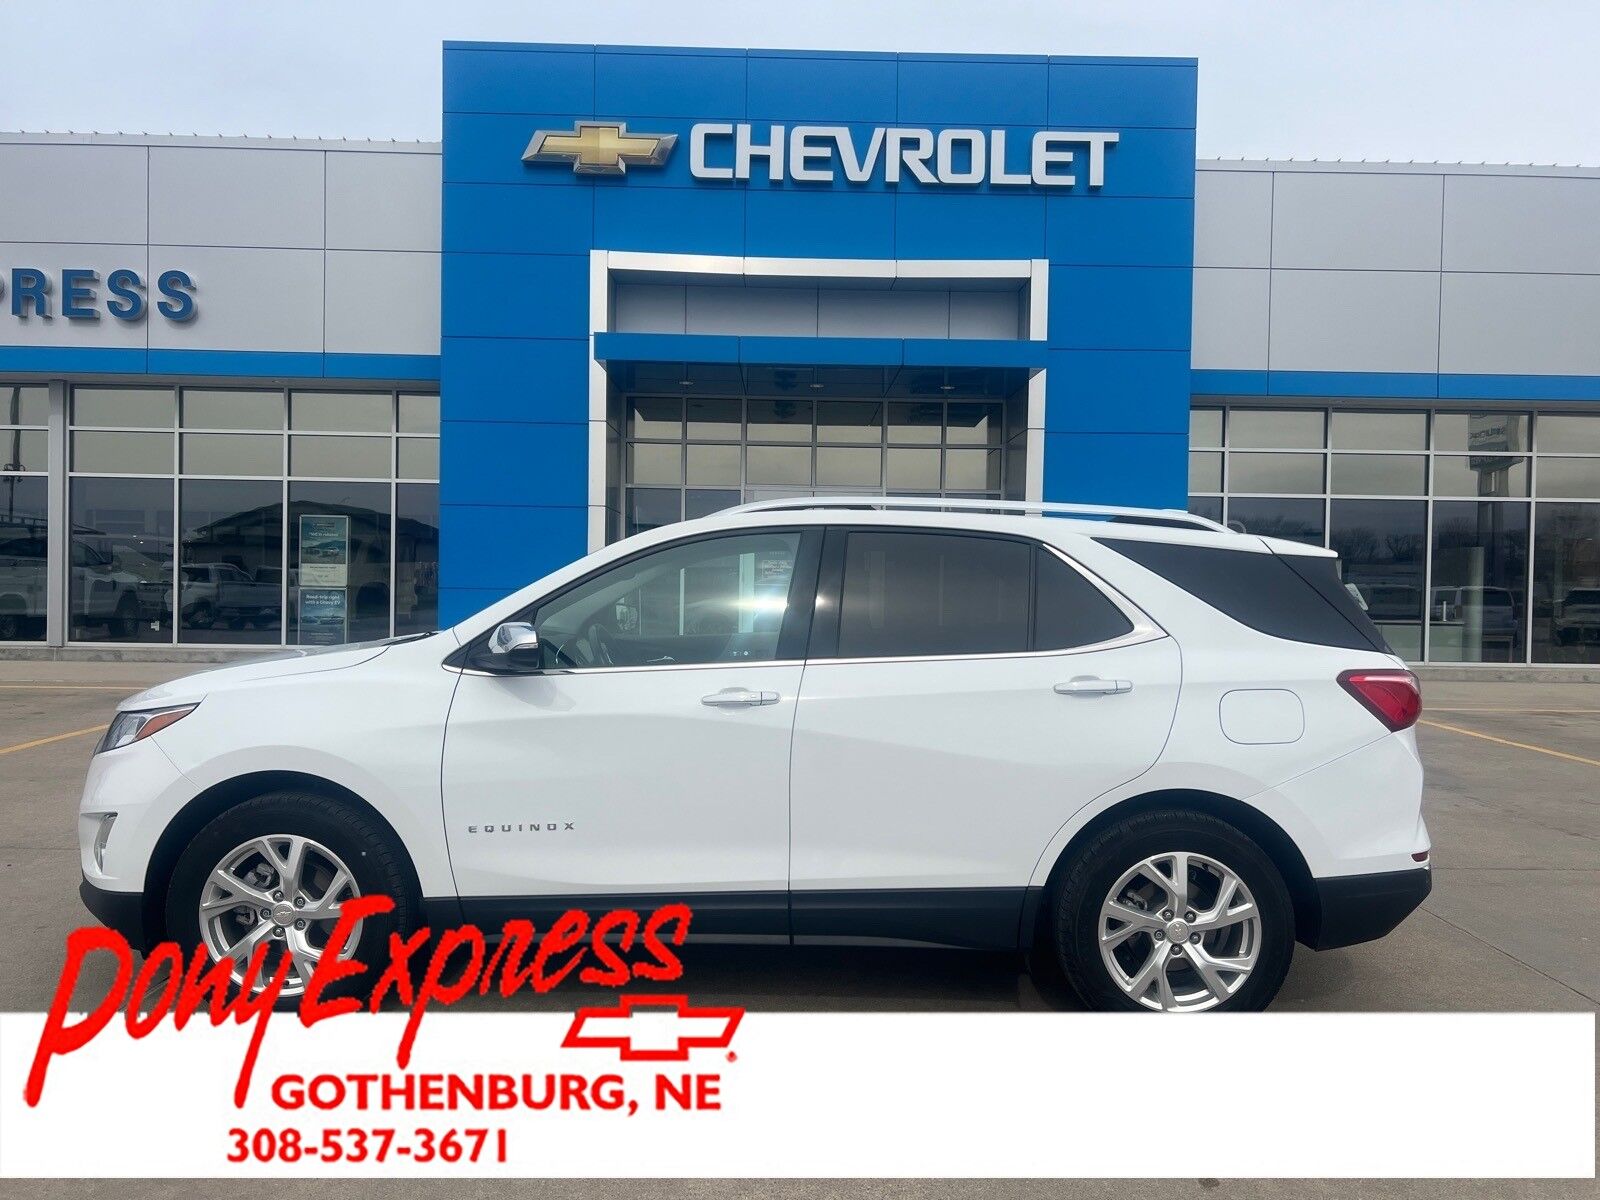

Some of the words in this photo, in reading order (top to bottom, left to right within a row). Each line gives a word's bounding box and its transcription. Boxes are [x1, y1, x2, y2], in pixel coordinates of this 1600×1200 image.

[690, 123, 1120, 188] CHEVROLET
[0, 267, 197, 323] RESS
[468, 821, 575, 834] EQUINOX
